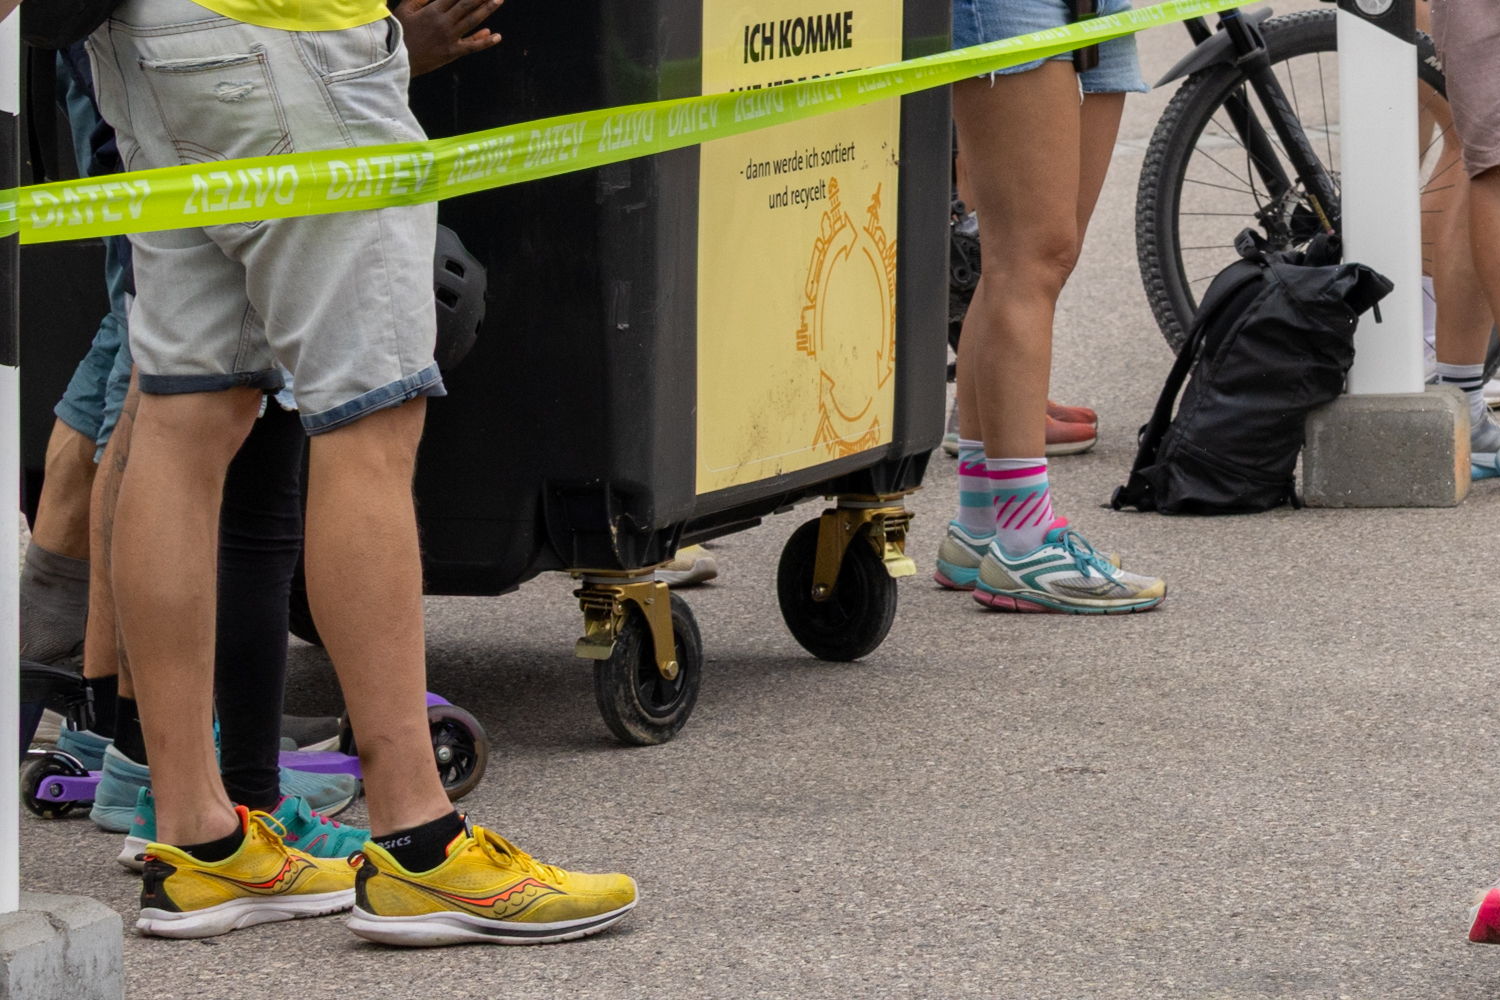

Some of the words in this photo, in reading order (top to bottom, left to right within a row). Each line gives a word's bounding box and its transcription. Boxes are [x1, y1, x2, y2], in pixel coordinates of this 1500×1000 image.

[743, 21, 775, 65] ICH
[779, 10, 853, 59] KOMME
[31, 180, 150, 229] DATEV
[183, 165, 299, 215] DATEV
[327, 152, 434, 201] DATEV
[522, 120, 588, 169] DATEV
[746, 157, 771, 180] dann
[773, 149, 804, 175] werde
[805, 146, 819, 169] ich
[821, 141, 856, 167] sortiert
[768, 184, 789, 210] und
[790, 178, 827, 210] recycelt
